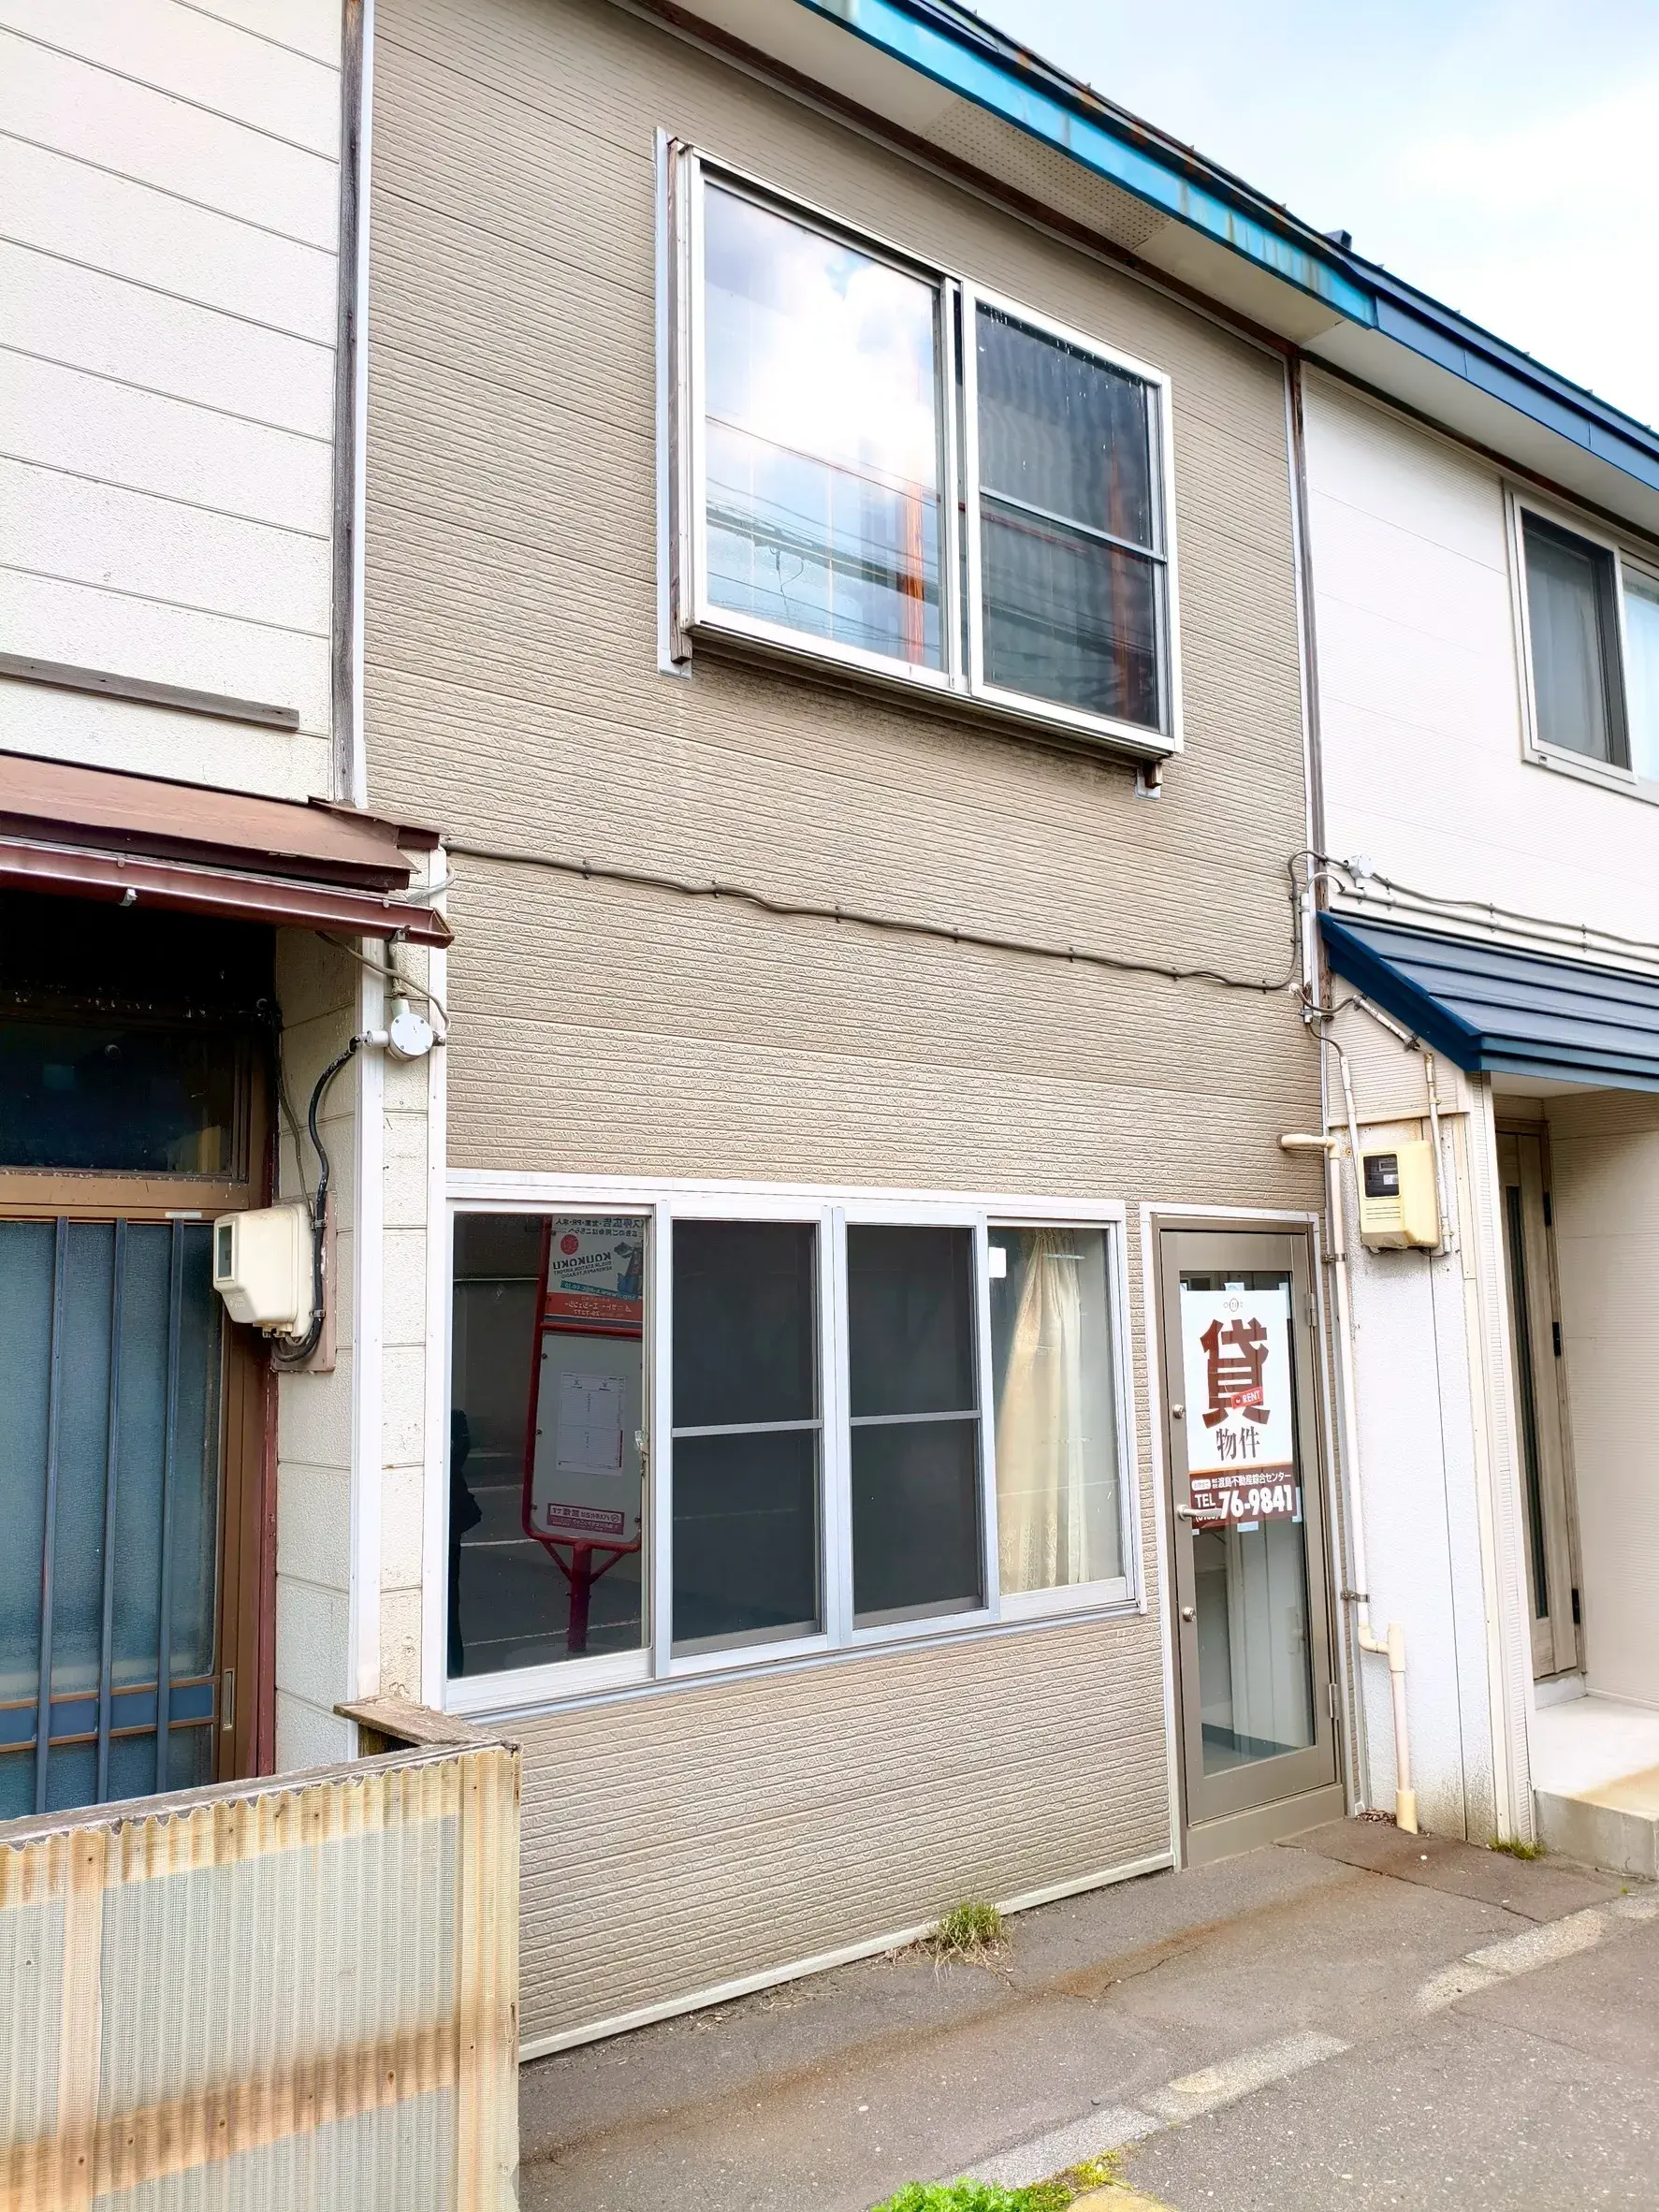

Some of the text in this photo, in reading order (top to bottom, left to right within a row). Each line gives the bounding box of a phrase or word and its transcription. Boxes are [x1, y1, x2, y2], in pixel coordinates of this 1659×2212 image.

[1200, 1317, 1270, 1429] 貸
[1242, 1390, 1260, 1404] RENT
[1215, 1426, 1260, 1462] 物件
[1194, 1484, 1293, 1520] TEL 76-9841
